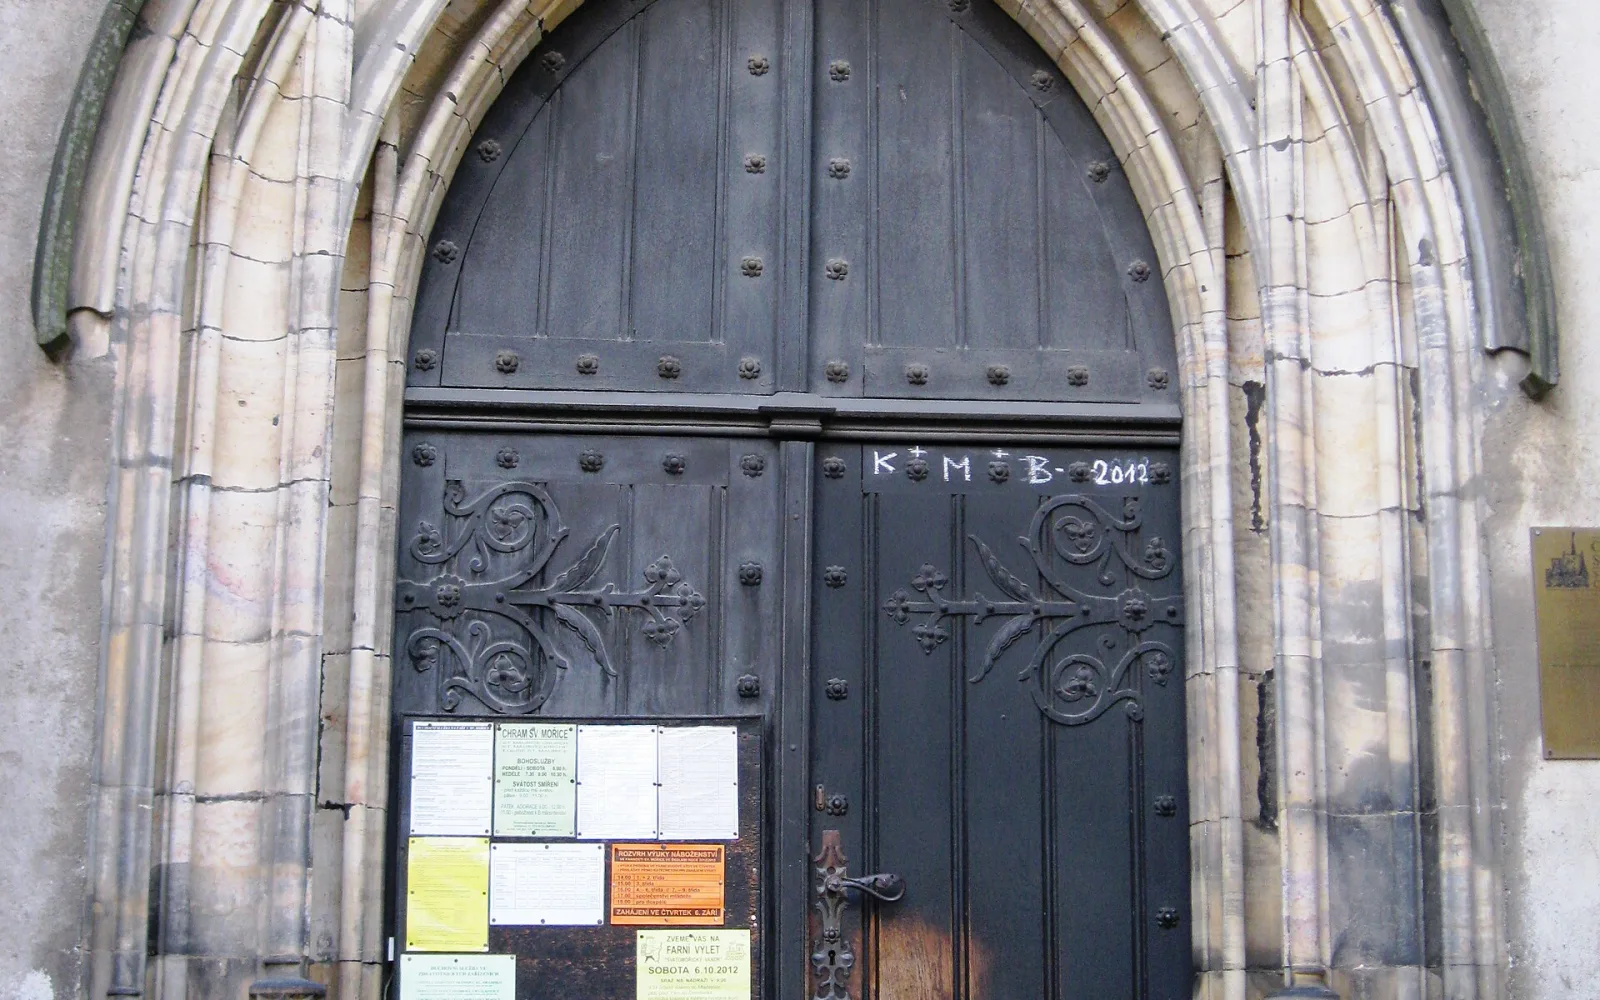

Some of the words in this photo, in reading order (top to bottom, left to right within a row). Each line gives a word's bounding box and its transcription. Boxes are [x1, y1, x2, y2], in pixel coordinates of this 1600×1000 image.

[873, 450, 898, 475] K
[943, 456, 971, 481] M
[1091, 458, 1149, 485] 2012
[648, 966, 690, 975] SOBOTA
